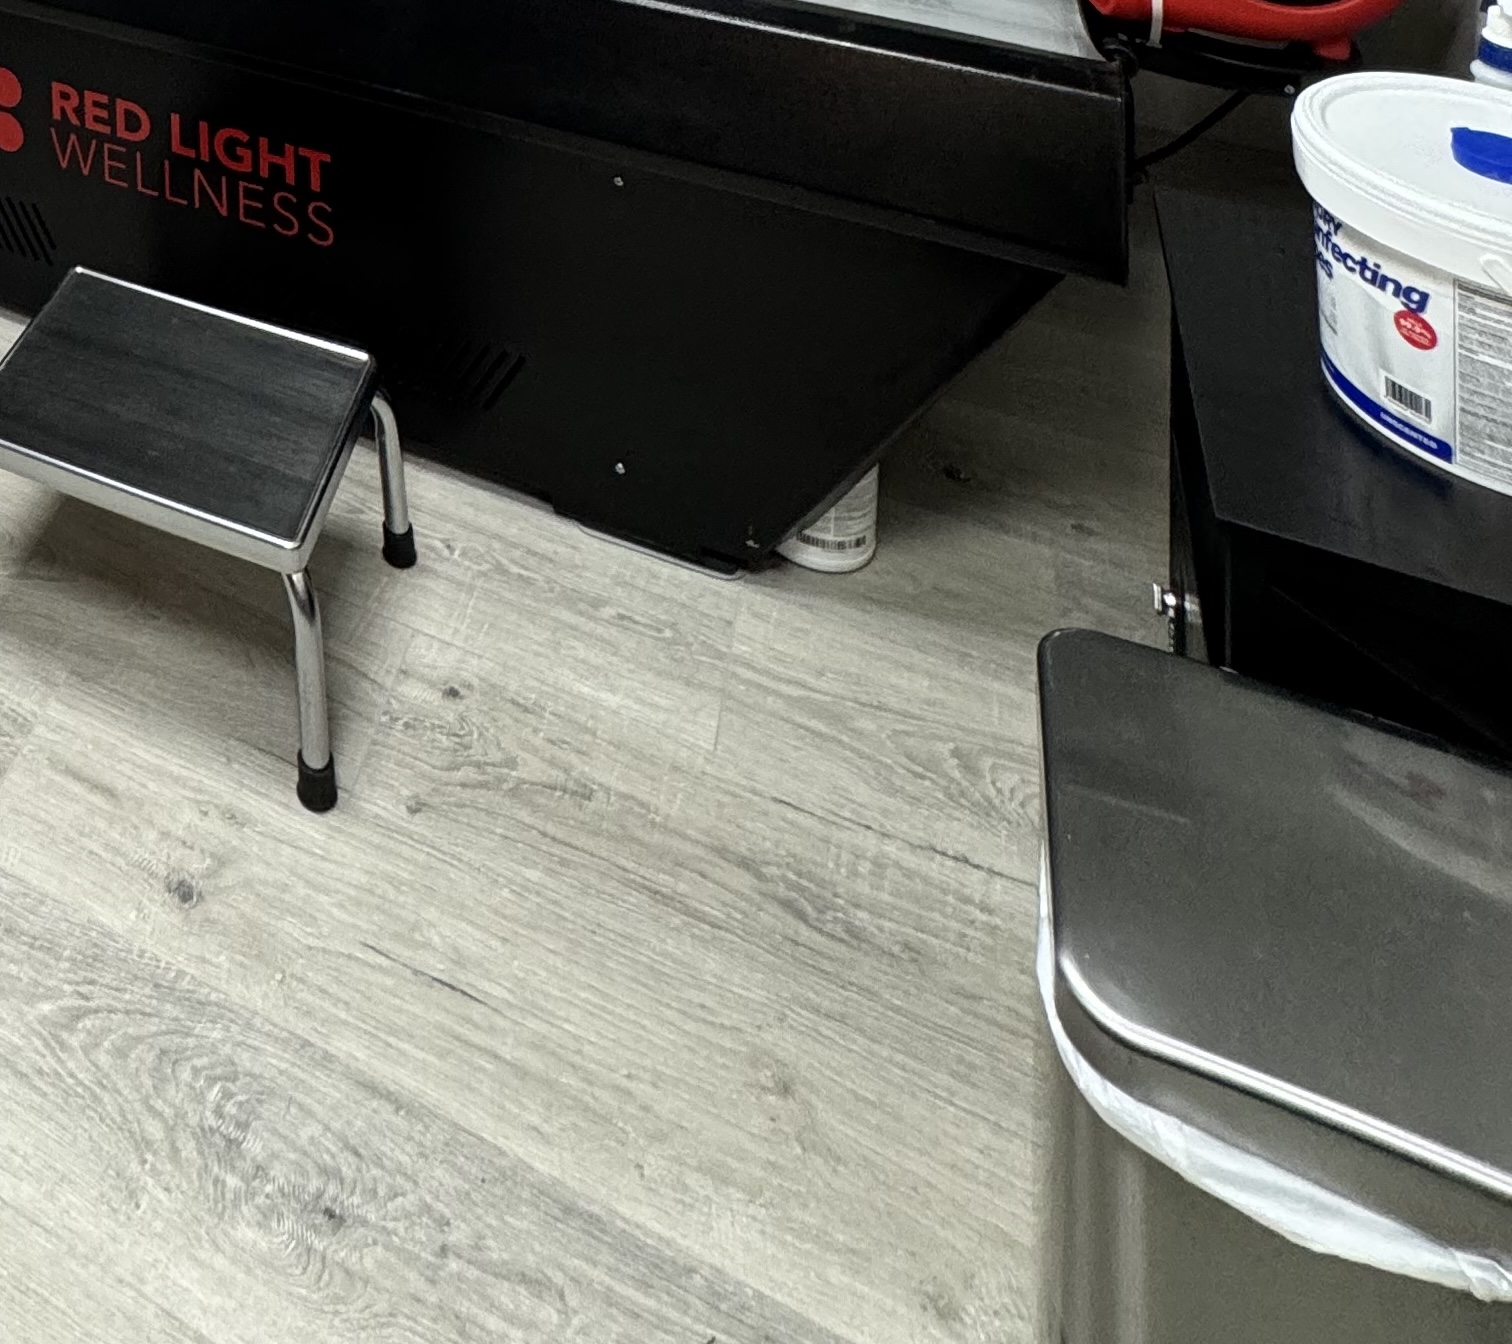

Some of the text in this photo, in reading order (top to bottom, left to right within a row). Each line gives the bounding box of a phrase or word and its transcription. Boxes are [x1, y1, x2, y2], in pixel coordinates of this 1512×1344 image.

[49, 127, 335, 247] WELLNESS
[51, 81, 331, 193] RED LIGHT
